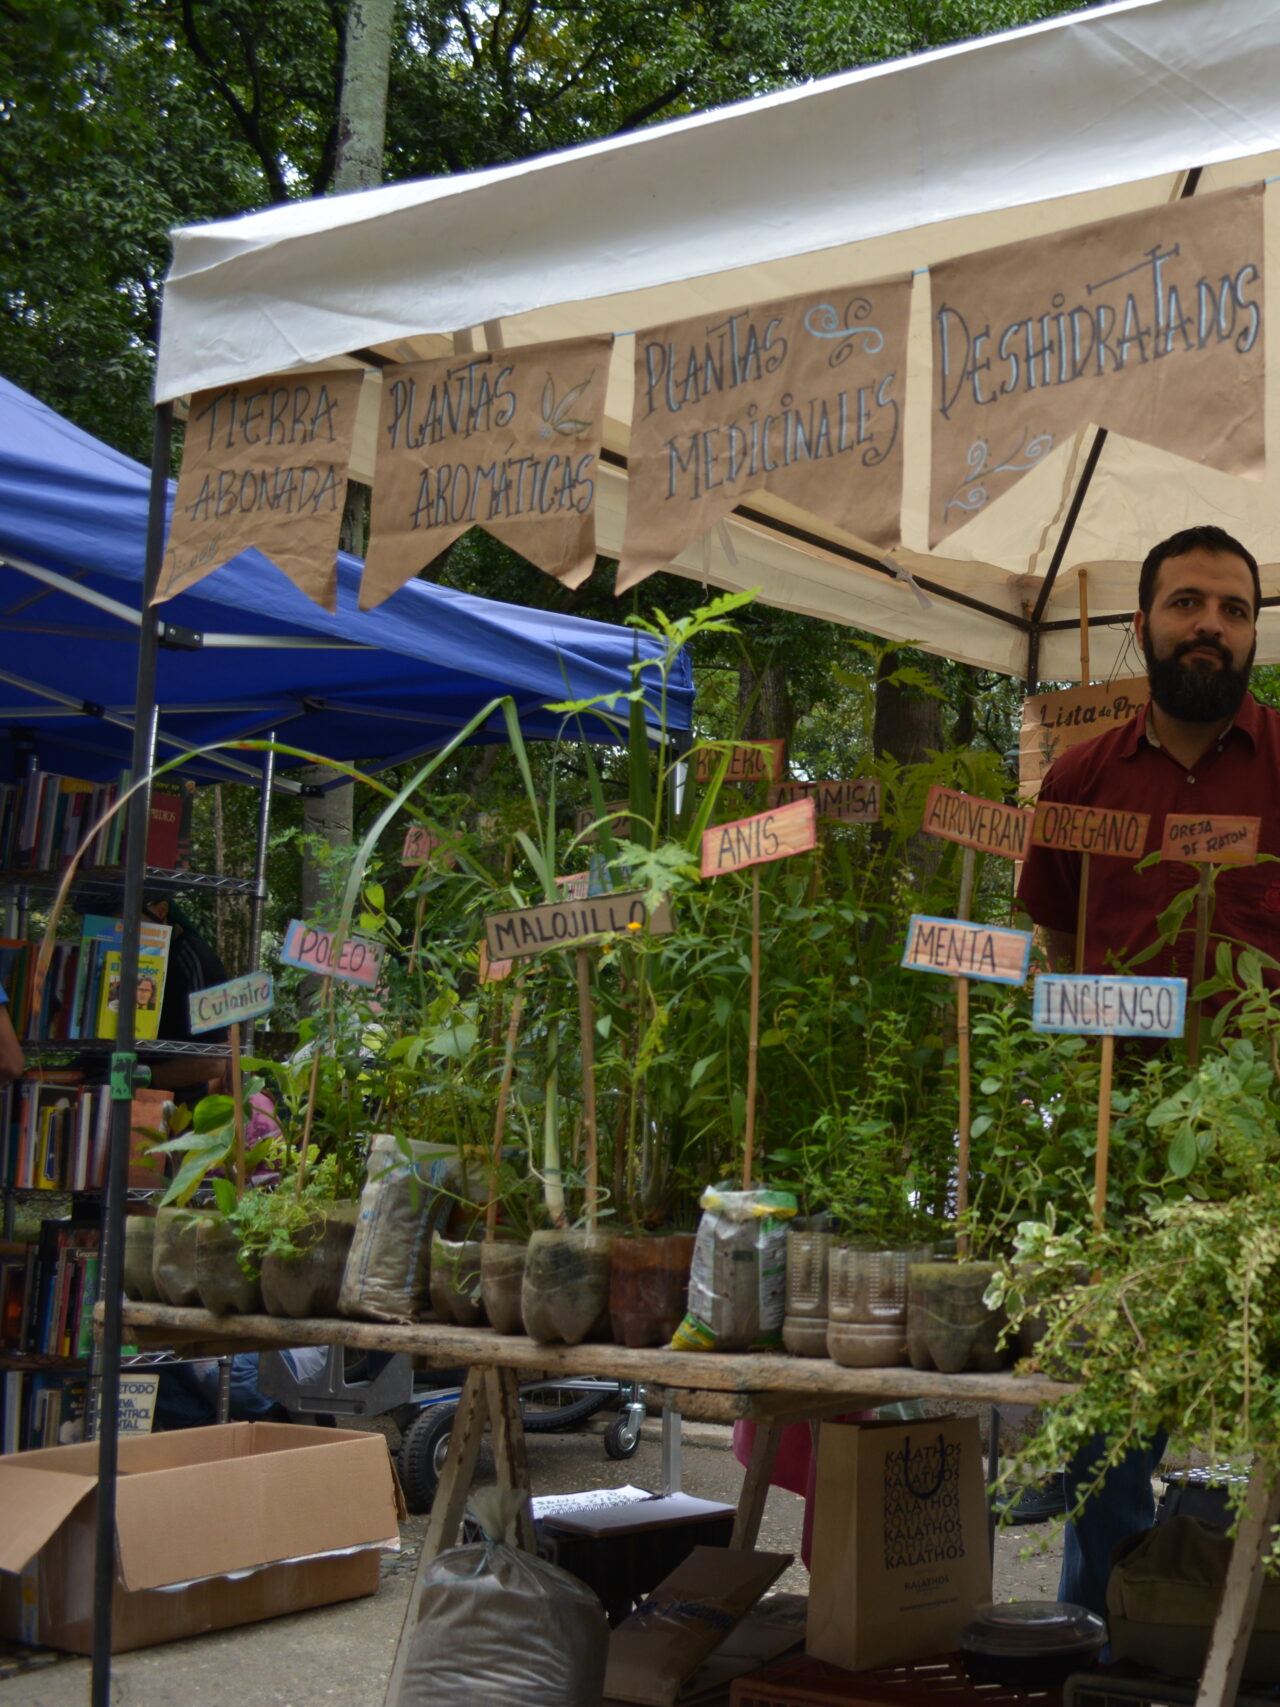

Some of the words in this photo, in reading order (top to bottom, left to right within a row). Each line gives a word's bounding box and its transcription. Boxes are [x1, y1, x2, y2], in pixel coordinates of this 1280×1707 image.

[933, 243, 1260, 418] DESHIDRATADOS
[643, 310, 788, 418] PLANTAS
[197, 384, 338, 450] TIERRA
[390, 355, 517, 451] PLANTAS
[665, 372, 899, 500] MEDICINALES
[185, 464, 344, 521] ABONADA
[1040, 703, 1097, 728] Lista
[1098, 706, 1111, 717] de
[697, 746, 766, 775] RERO
[718, 816, 779, 868] ANIS
[929, 793, 1028, 854] ATROVERAN
[1043, 807, 1139, 852] OREGANO
[1170, 820, 1212, 840] OREJA
[1182, 841, 1197, 856] DE
[1207, 825, 1247, 852] RATON
[495, 901, 646, 950] MALOJILLO
[915, 924, 996, 974] MENTA
[298, 929, 366, 972] POLEO
[198, 981, 270, 1021] Culantro
[1041, 980, 1172, 1031] INCIENSO
[884, 1468, 960, 1490] KAATHOS
[884, 1494, 960, 1516] KALATHOS
[884, 1519, 962, 1544] KALATHOS
[885, 1544, 965, 1570] KALATHOS
